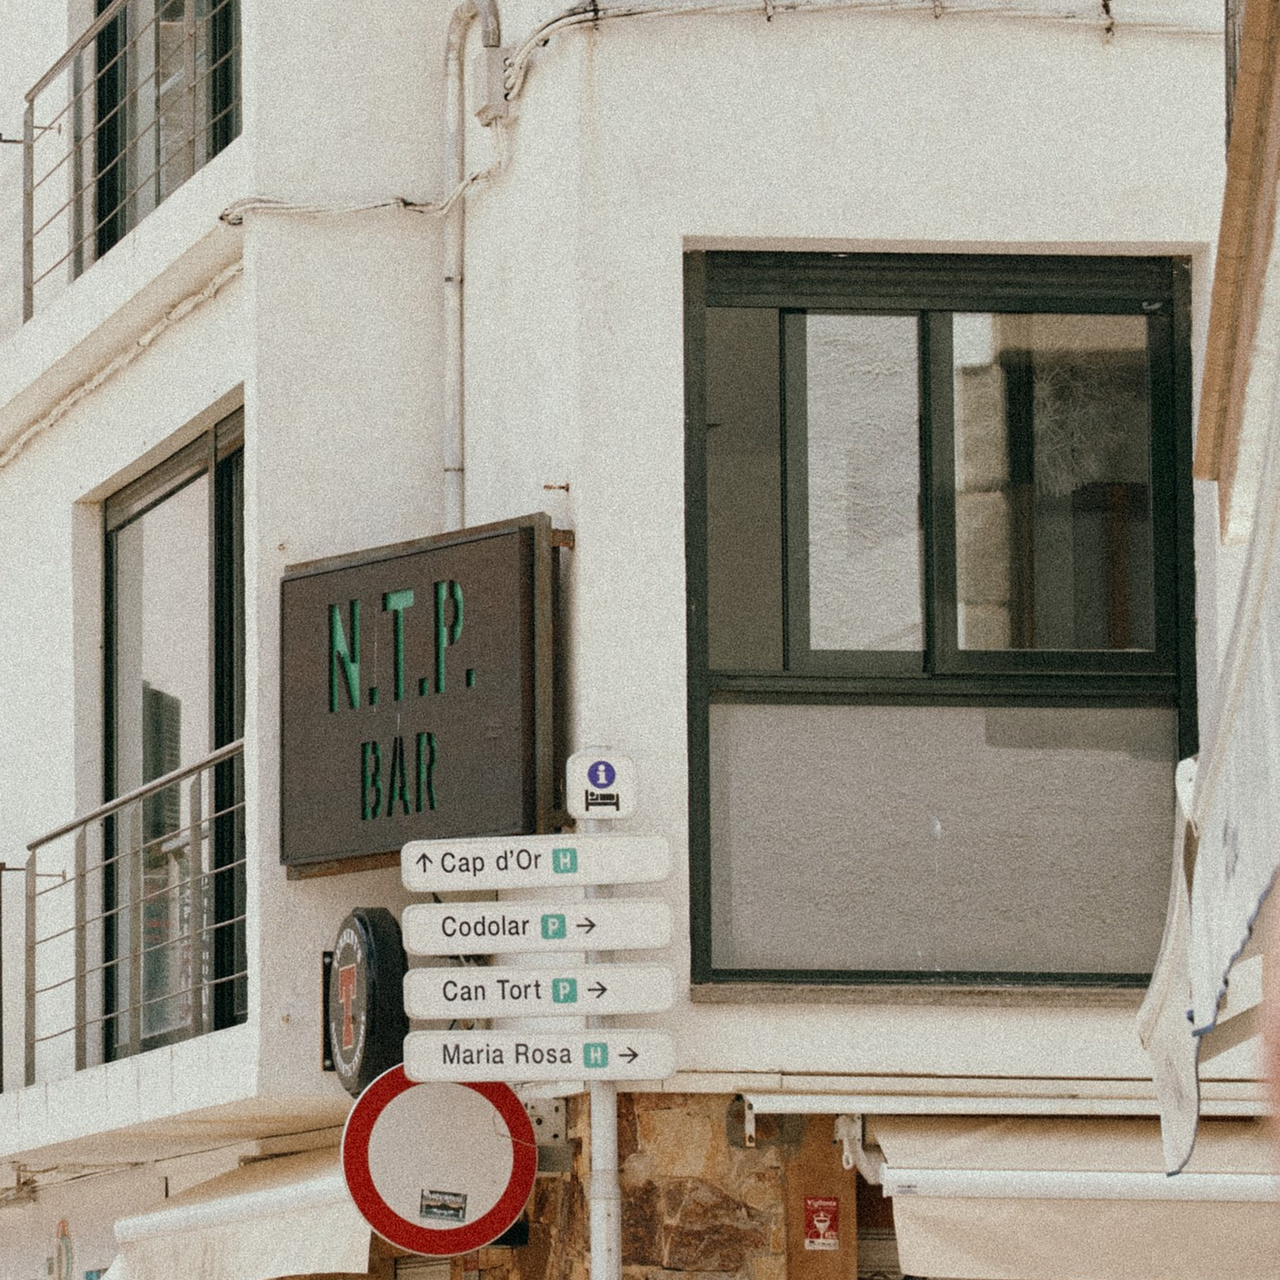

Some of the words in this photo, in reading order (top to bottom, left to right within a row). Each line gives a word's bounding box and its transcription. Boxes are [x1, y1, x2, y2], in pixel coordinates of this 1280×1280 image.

[328, 580, 475, 713] N.T.P.
[361, 731, 437, 821] BAR
[441, 852, 485, 877] Cap
[496, 849, 542, 871] d'Or
[441, 916, 529, 937] Codolar
[442, 980, 486, 1002] Can
[497, 979, 541, 1000] Tort
[442, 1043, 504, 1064] Maria
[515, 1043, 571, 1064] Rosa
